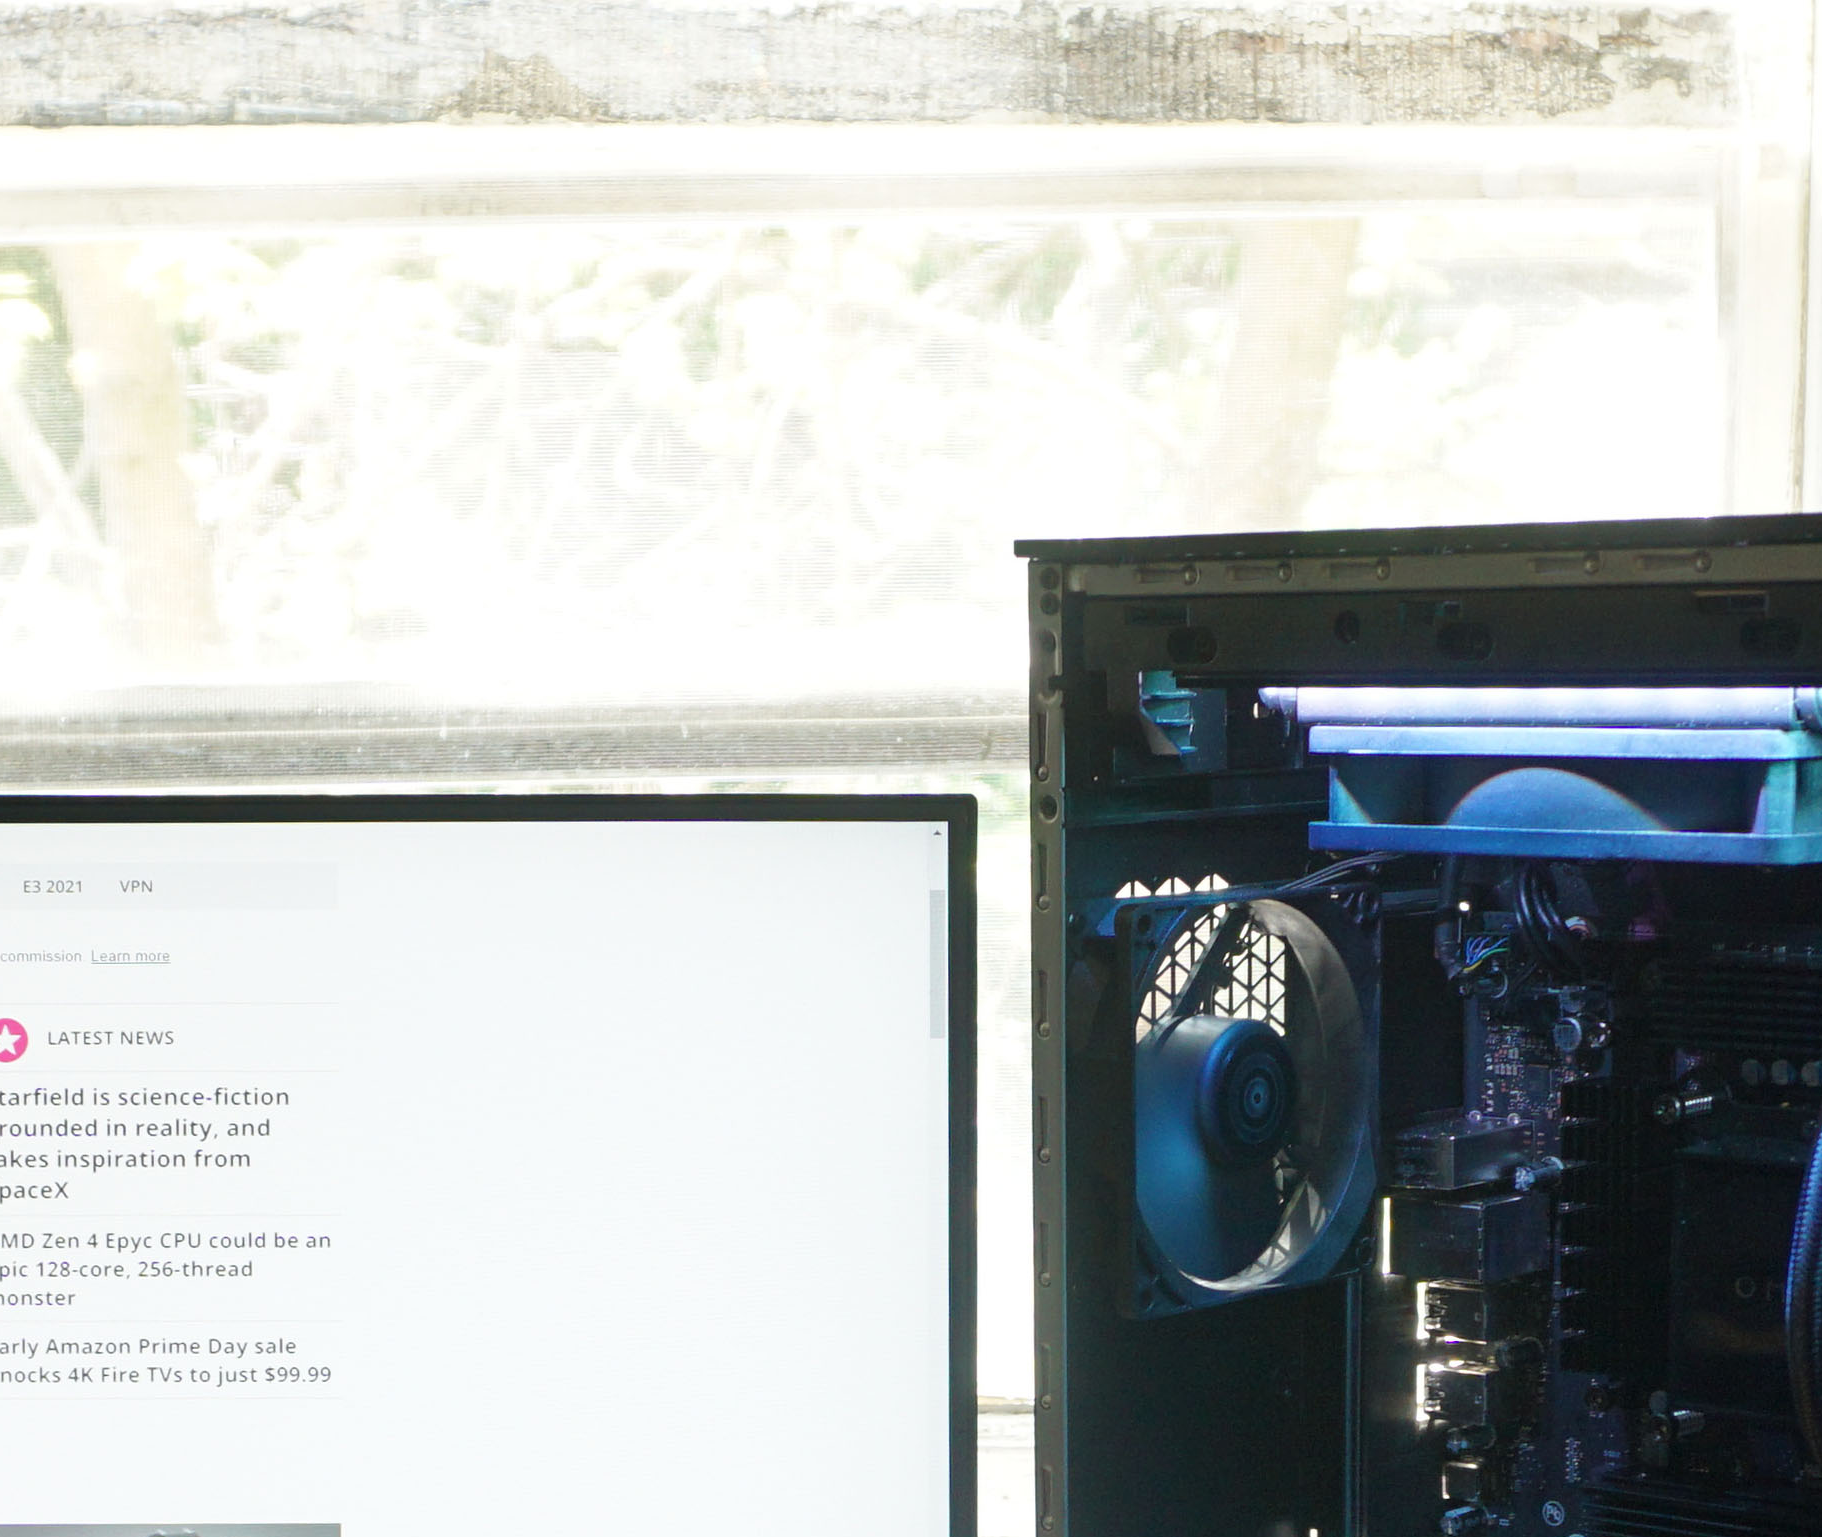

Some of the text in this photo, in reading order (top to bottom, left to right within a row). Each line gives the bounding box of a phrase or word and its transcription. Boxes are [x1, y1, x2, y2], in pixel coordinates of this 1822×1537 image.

[23, 880, 84, 894] E3 2021
[119, 880, 154, 893] VPN
[91, 949, 131, 963] Learn
[135, 953, 171, 963] more
[47, 1030, 175, 1046] LATEST NEWS
[93, 1089, 110, 1107] is
[118, 1087, 290, 1107] science-fiction
[106, 1118, 127, 1137] in
[135, 1117, 218, 1142] reality,
[226, 1118, 271, 1137] and
[57, 1149, 187, 1173] inspiration
[193, 1149, 252, 1168] from
[41, 1232, 80, 1250] Zen
[87, 1233, 99, 1249] 4
[105, 1232, 152, 1254] Epyc
[159, 1232, 202, 1250] CPU
[208, 1231, 267, 1249] could
[274, 1231, 299, 1249] be
[305, 1236, 332, 1249] an
[36, 1261, 131, 1280] 128-core,
[137, 1260, 254, 1279] 256-thread
[45, 1338, 131, 1356] Amazon
[139, 1338, 201, 1356] Prime
[208, 1338, 248, 1359] Day
[254, 1337, 297, 1355] sale
[68, 1366, 94, 1383] 4K
[101, 1366, 140, 1384] Fire
[147, 1366, 183, 1384] TVs
[190, 1368, 212, 1383] to
[216, 1366, 258, 1387] just
[264, 1365, 332, 1385] $99.99
